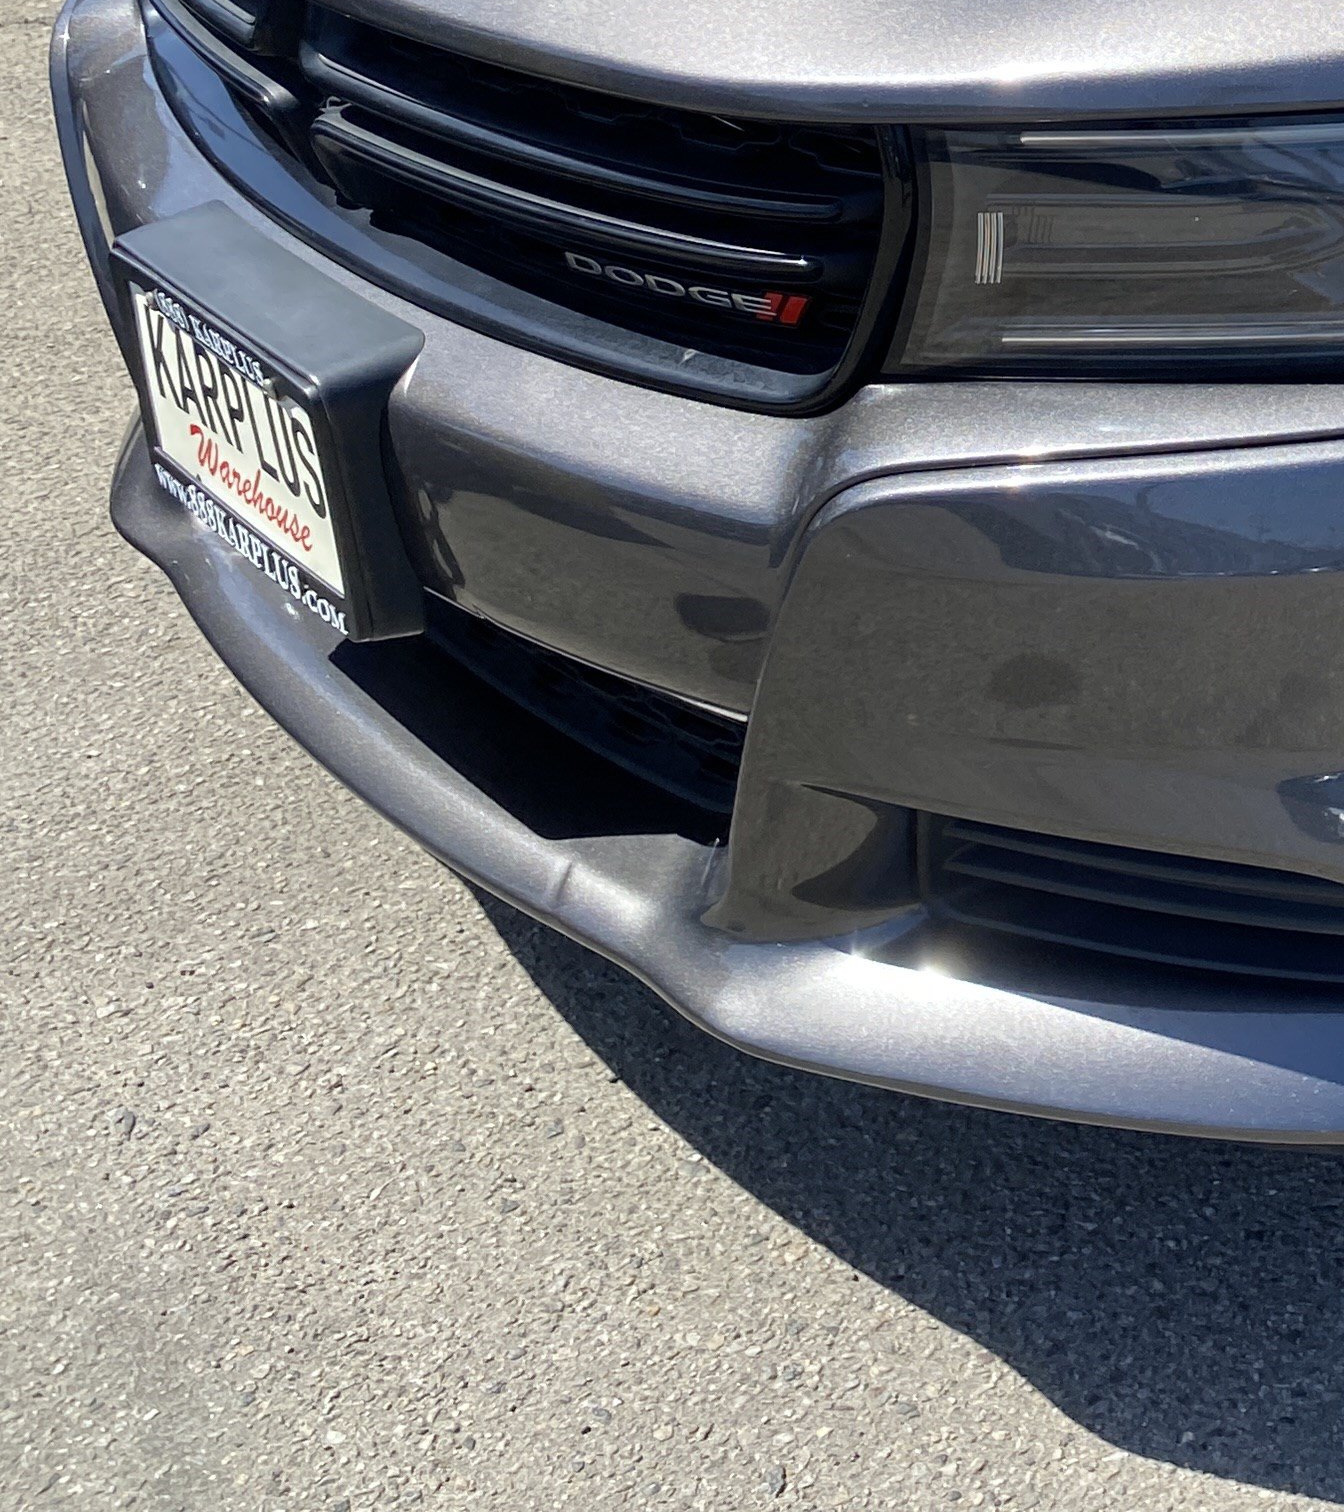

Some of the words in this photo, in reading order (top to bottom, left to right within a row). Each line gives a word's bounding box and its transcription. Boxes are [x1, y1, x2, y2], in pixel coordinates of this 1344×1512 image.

[564, 250, 778, 318] DODGE
[188, 314, 264, 388] KARPLUS
[143, 303, 327, 520] KARPLUS
[190, 423, 313, 552] Warehouse
